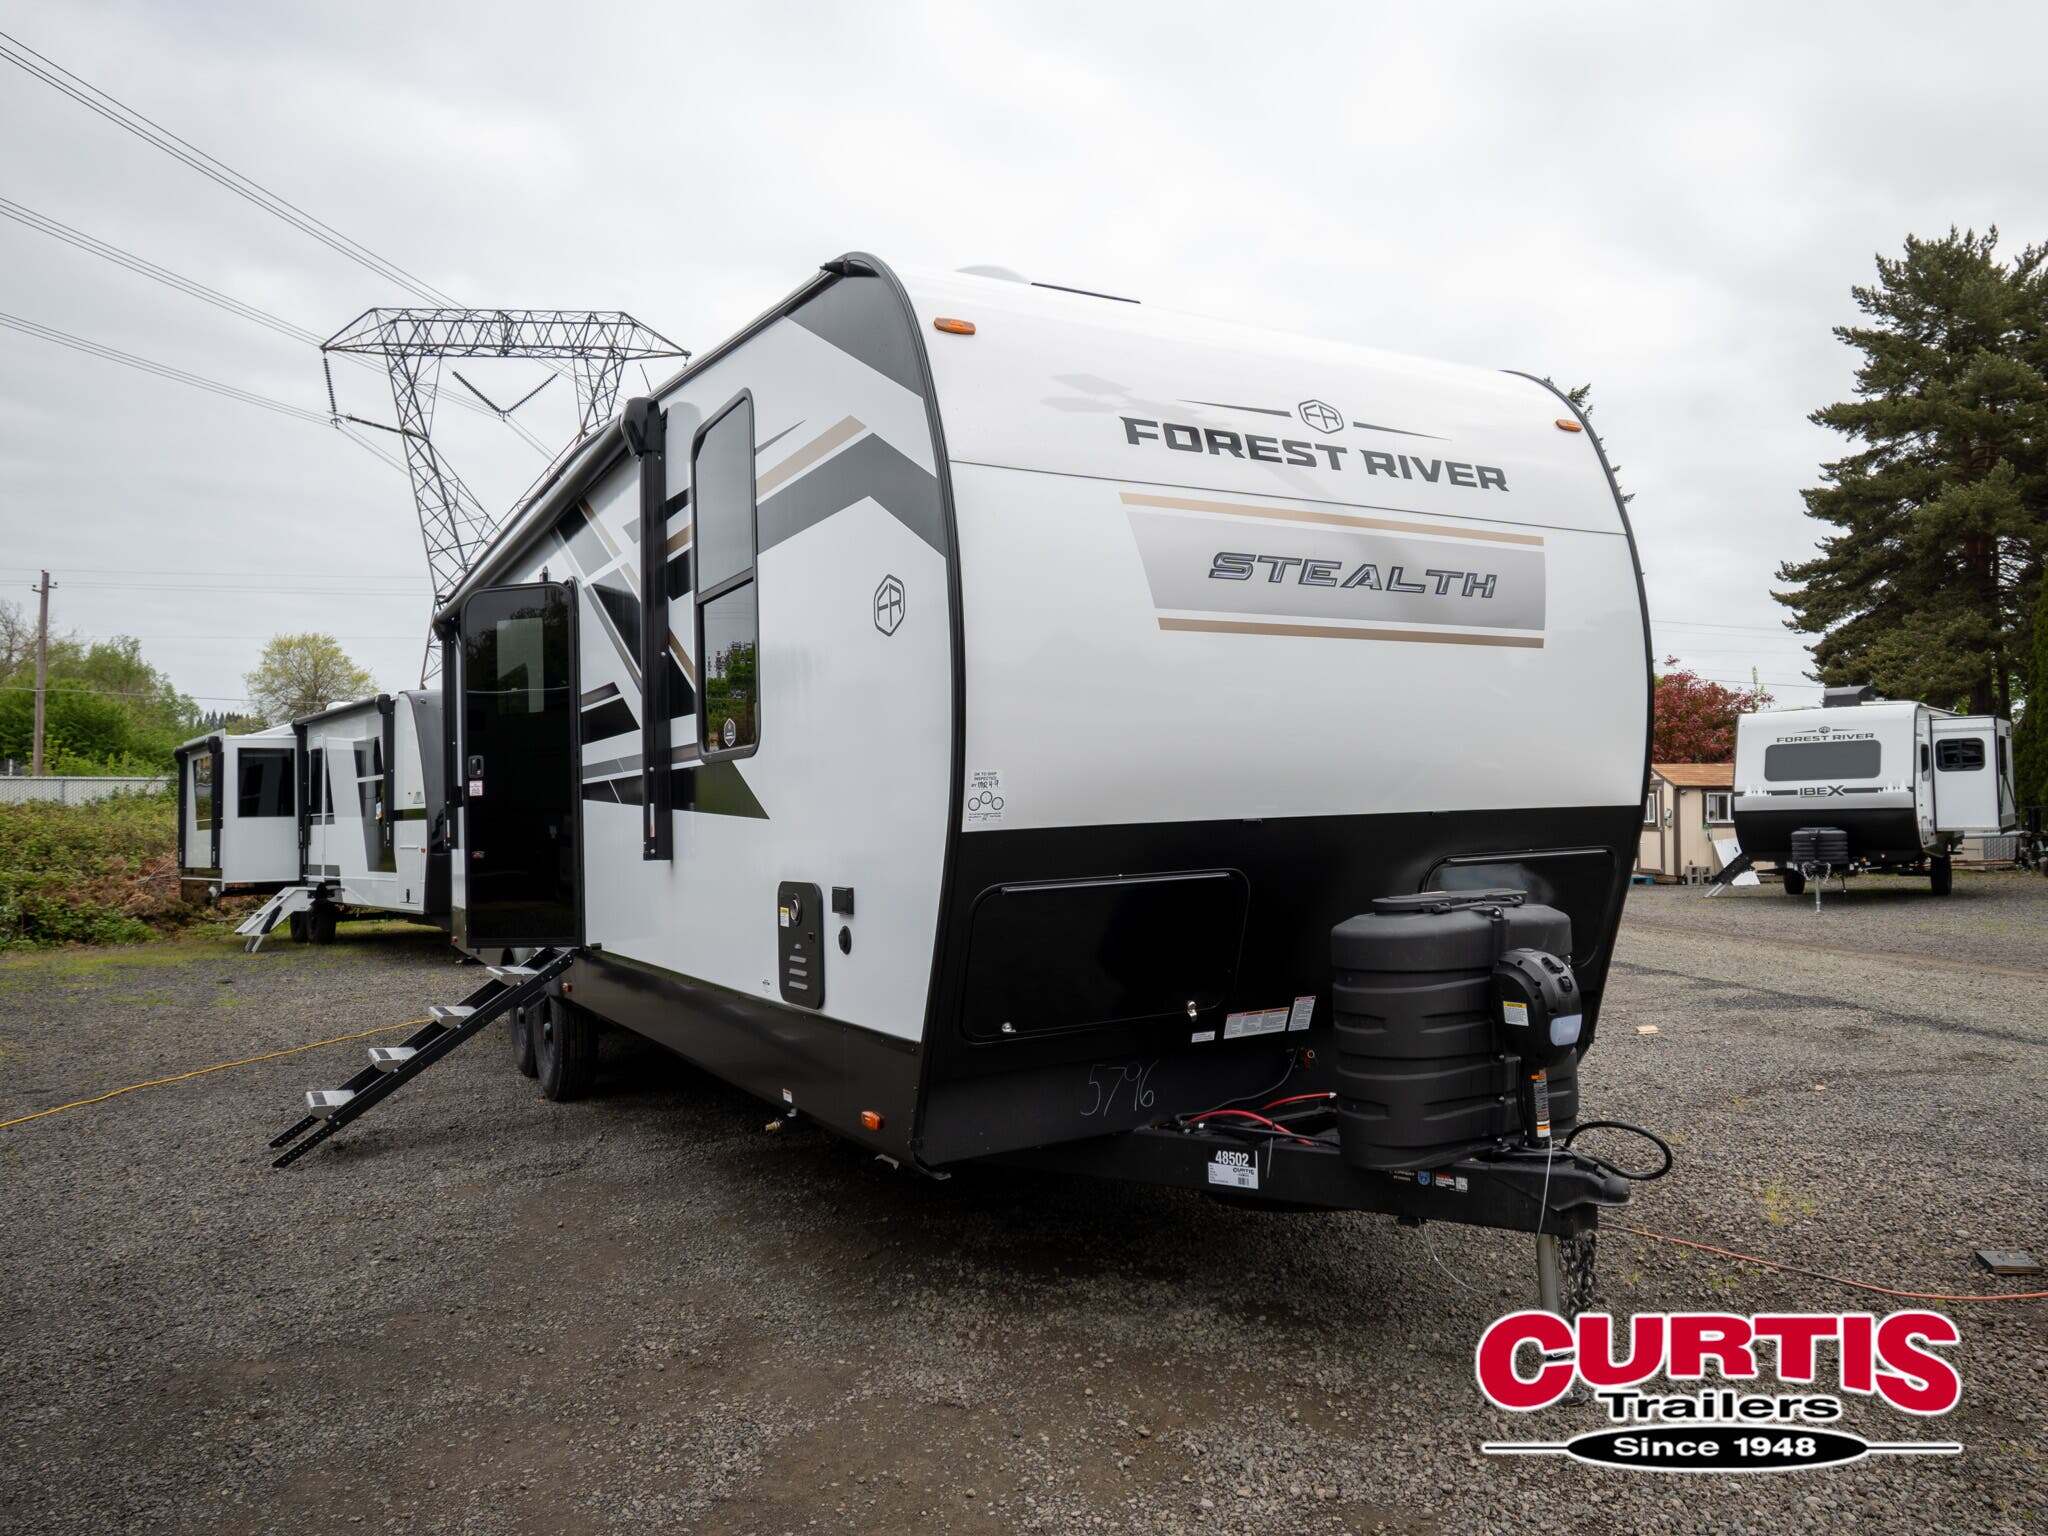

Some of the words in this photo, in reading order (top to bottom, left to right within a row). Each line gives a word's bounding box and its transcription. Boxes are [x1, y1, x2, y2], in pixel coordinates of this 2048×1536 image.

[1120, 416, 1347, 471] FOREST
[1359, 447, 1510, 492] RIVER
[1208, 551, 1498, 599] STEALTH
[1776, 735, 1829, 744] FOREST
[1832, 733, 1875, 741] RIVER
[1800, 785, 1844, 797] IBEX
[1080, 1060, 1159, 1116] 5796
[1215, 1150, 1249, 1167] 48502
